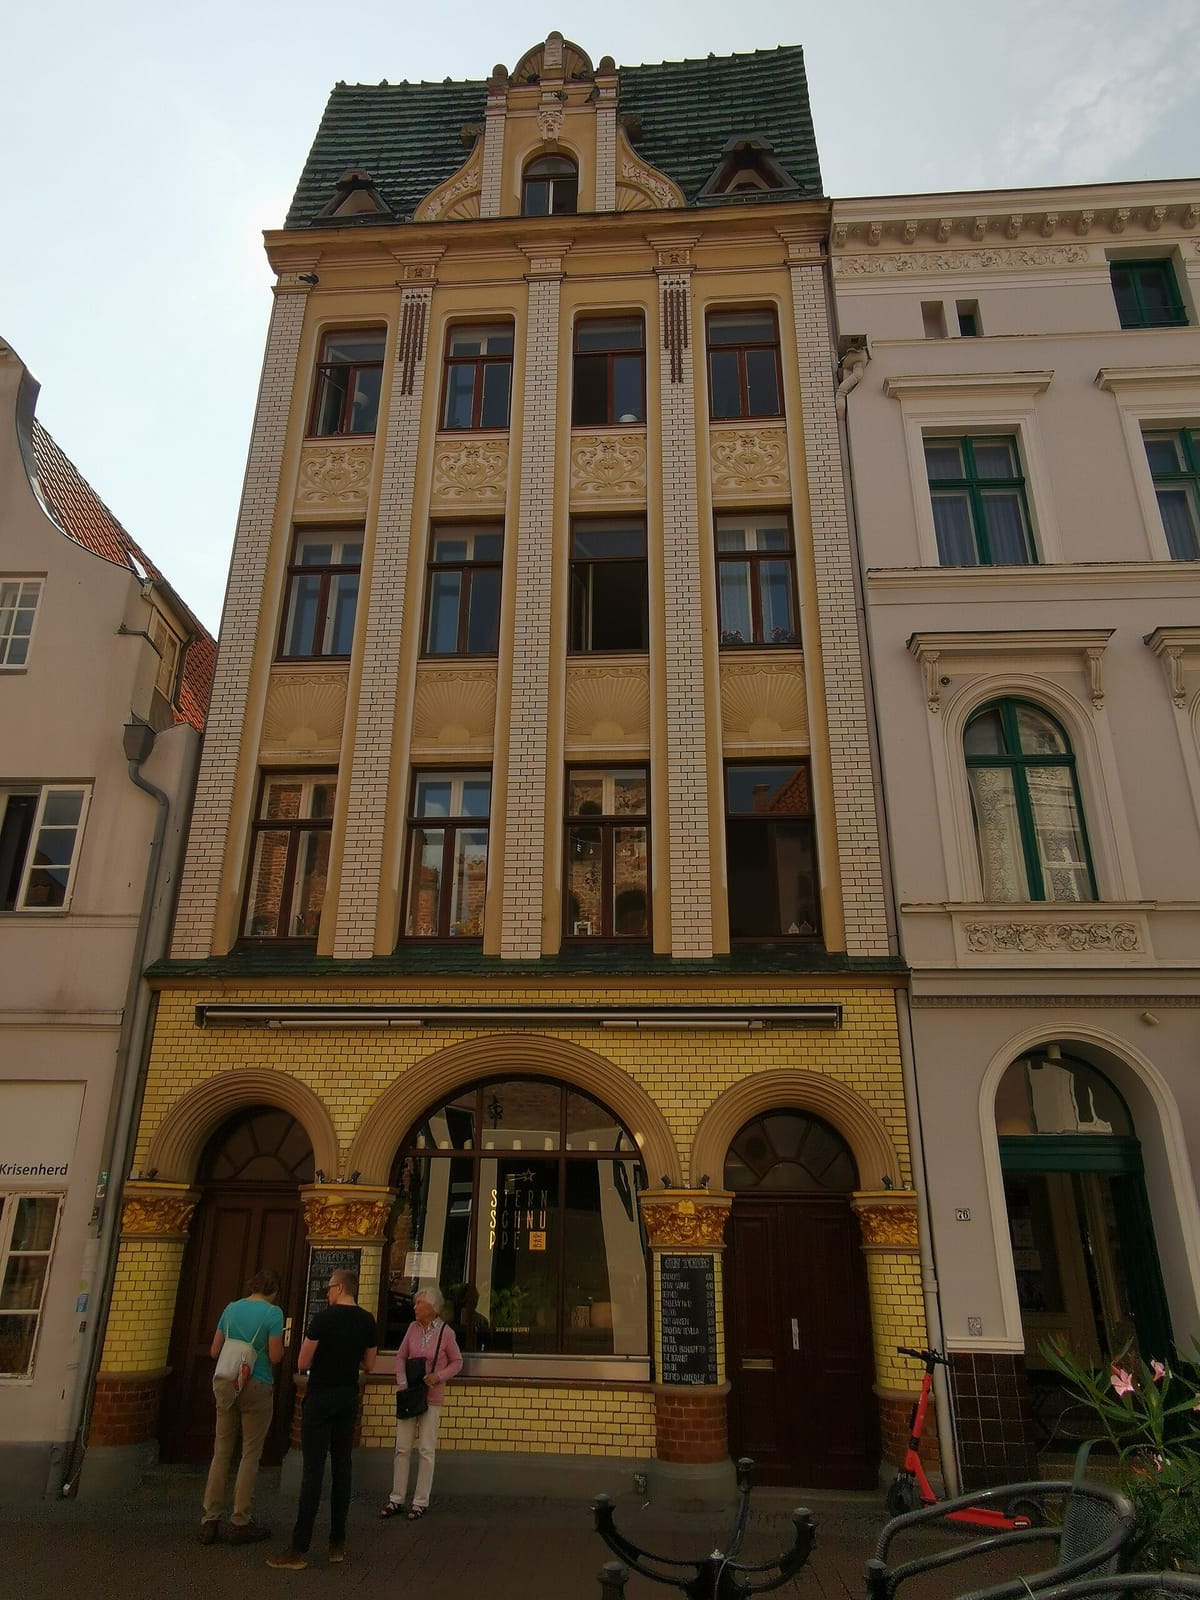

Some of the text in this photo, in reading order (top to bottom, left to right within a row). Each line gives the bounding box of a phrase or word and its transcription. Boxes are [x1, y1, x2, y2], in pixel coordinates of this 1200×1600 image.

[0, 1163, 69, 1176] Krisenherd
[490, 1188, 548, 1208] STERN
[489, 1209, 546, 1229] SCHNU
[489, 1230, 521, 1250] PPE
